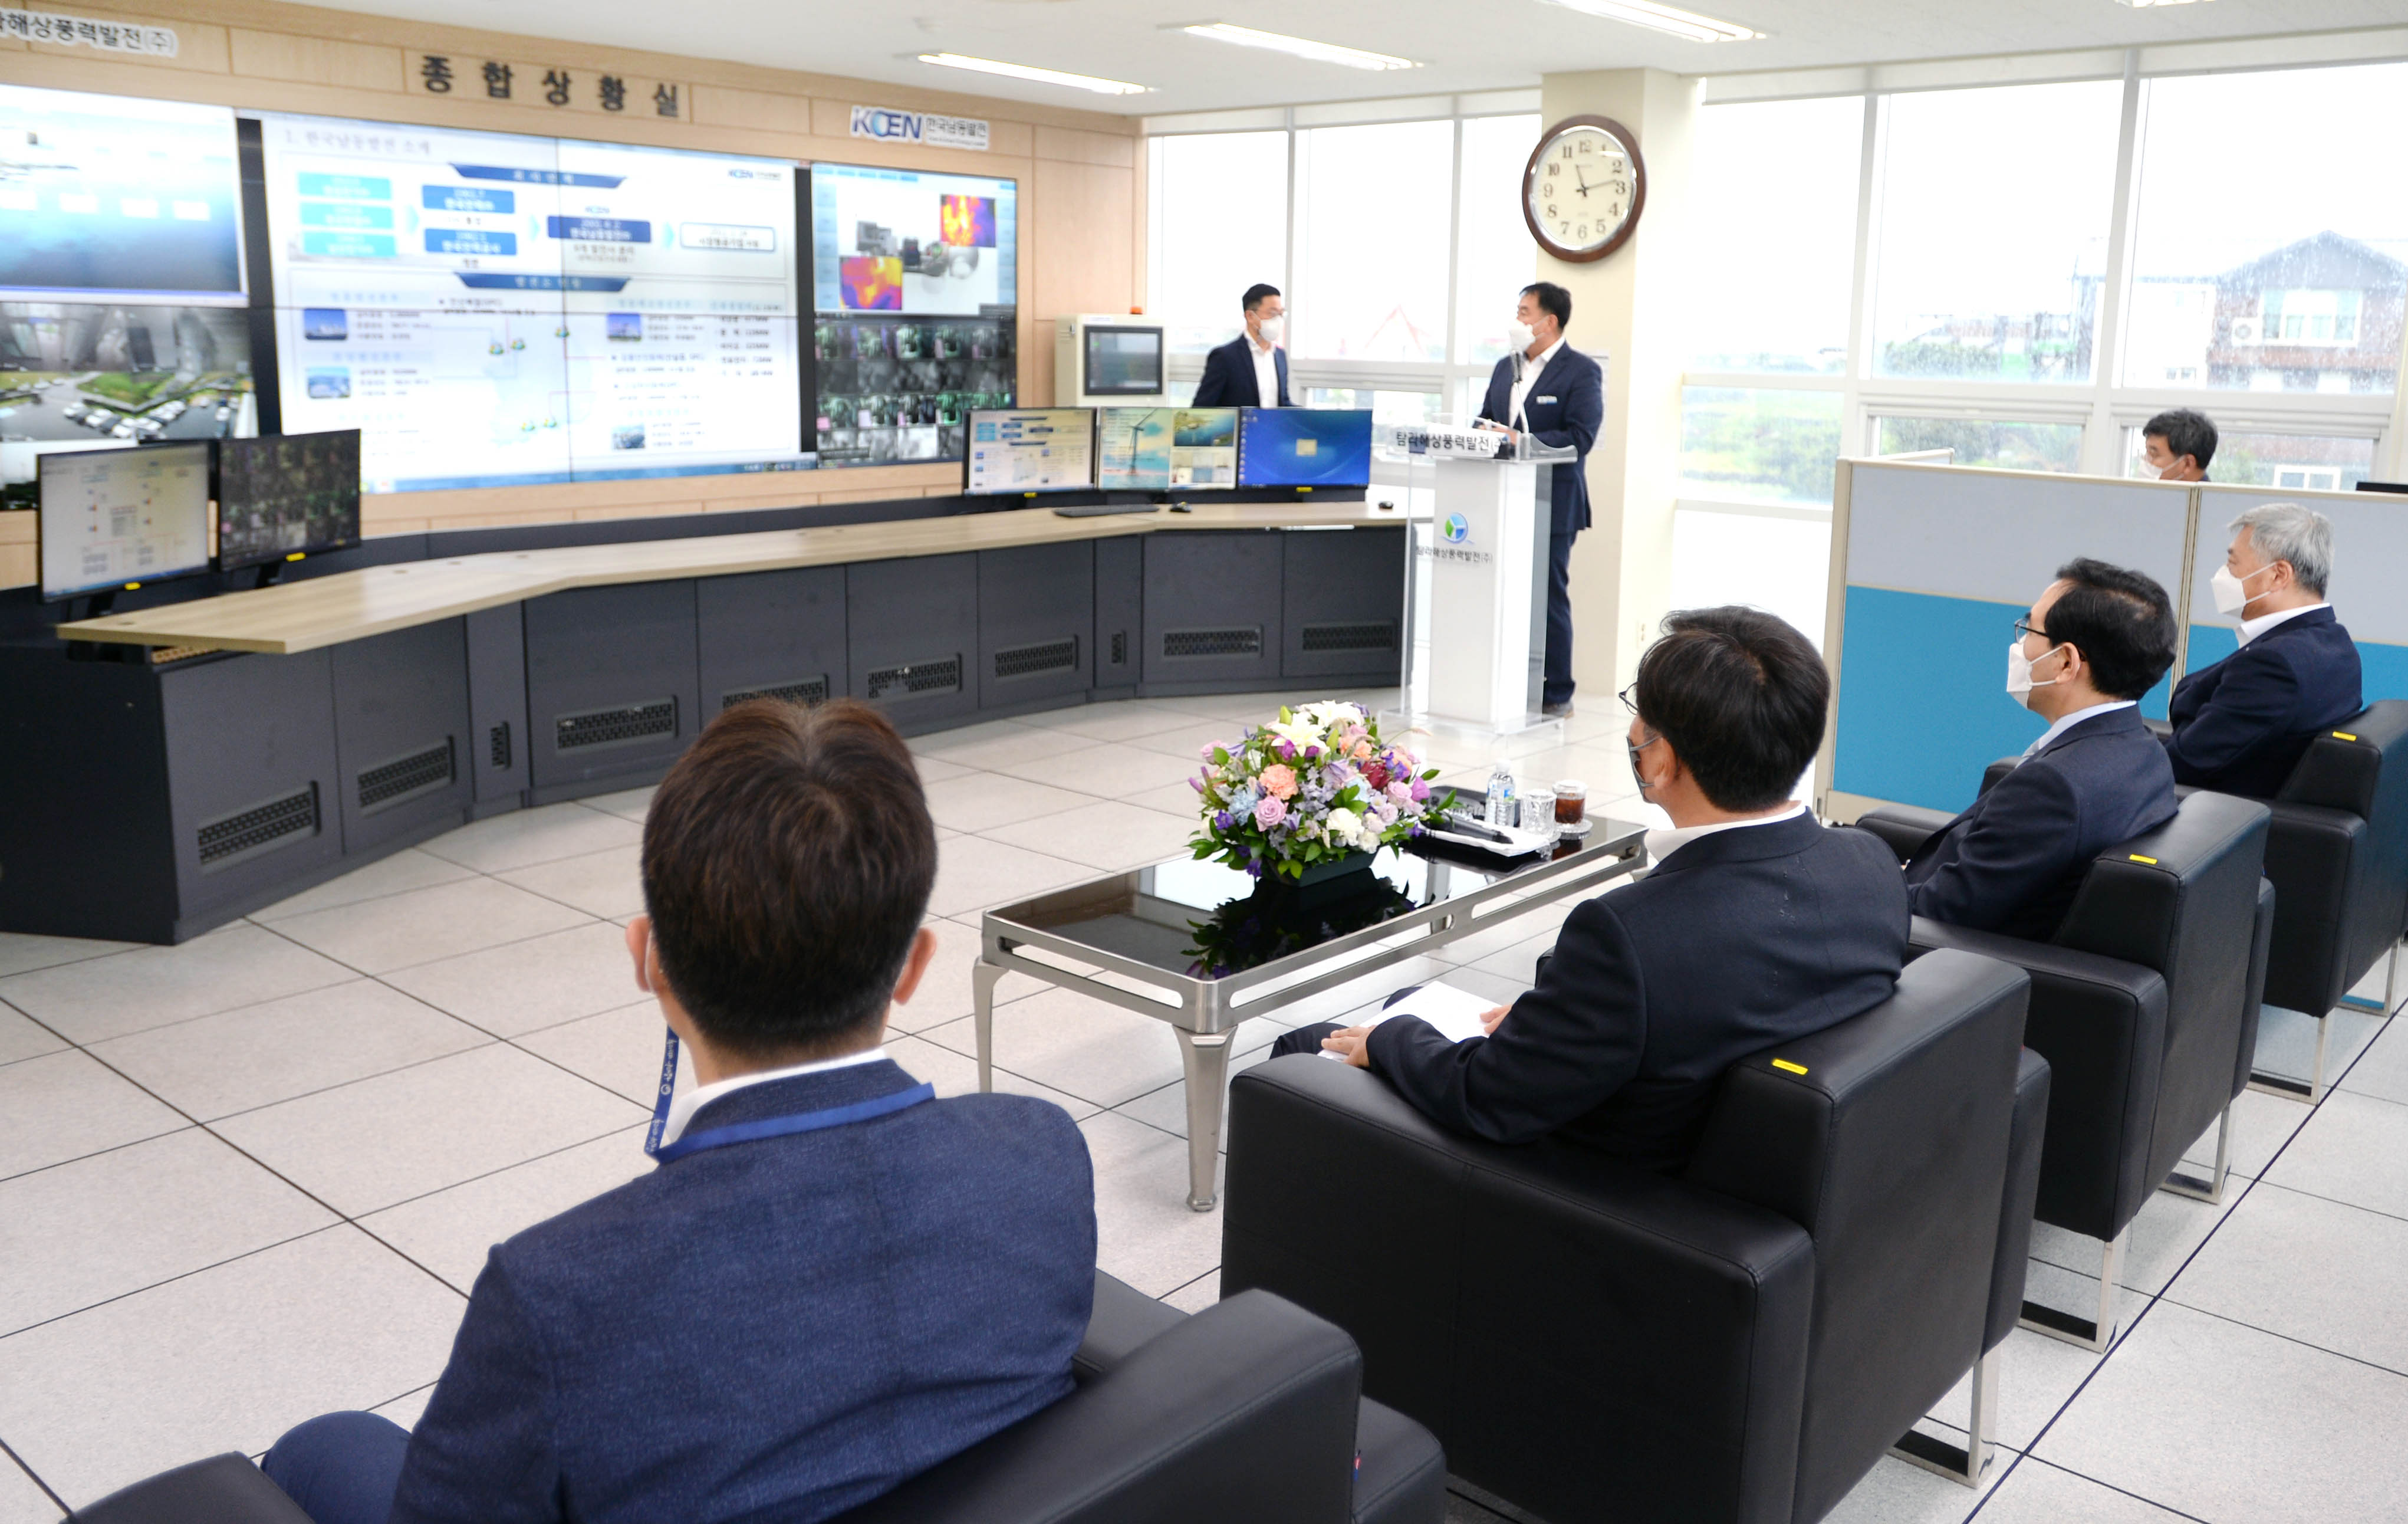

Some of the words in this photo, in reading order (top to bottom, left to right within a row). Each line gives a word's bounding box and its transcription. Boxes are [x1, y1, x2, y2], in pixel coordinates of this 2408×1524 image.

[0, 12, 174, 54] 해상풍력발전(주)
[852, 108, 922, 139] KOEN
[1562, 145, 1573, 159] 11
[1578, 140, 1592, 153] 12
[1548, 163, 1560, 176] 10
[1612, 160, 1623, 173] 2
[1544, 183, 1554, 198] 9
[1615, 180, 1626, 195] 3
[1547, 205, 1558, 218] 8
[1608, 203, 1619, 216] 4
[1560, 221, 1570, 235] 7
[1577, 224, 1588, 239] 6
[1596, 219, 1606, 234] 5
